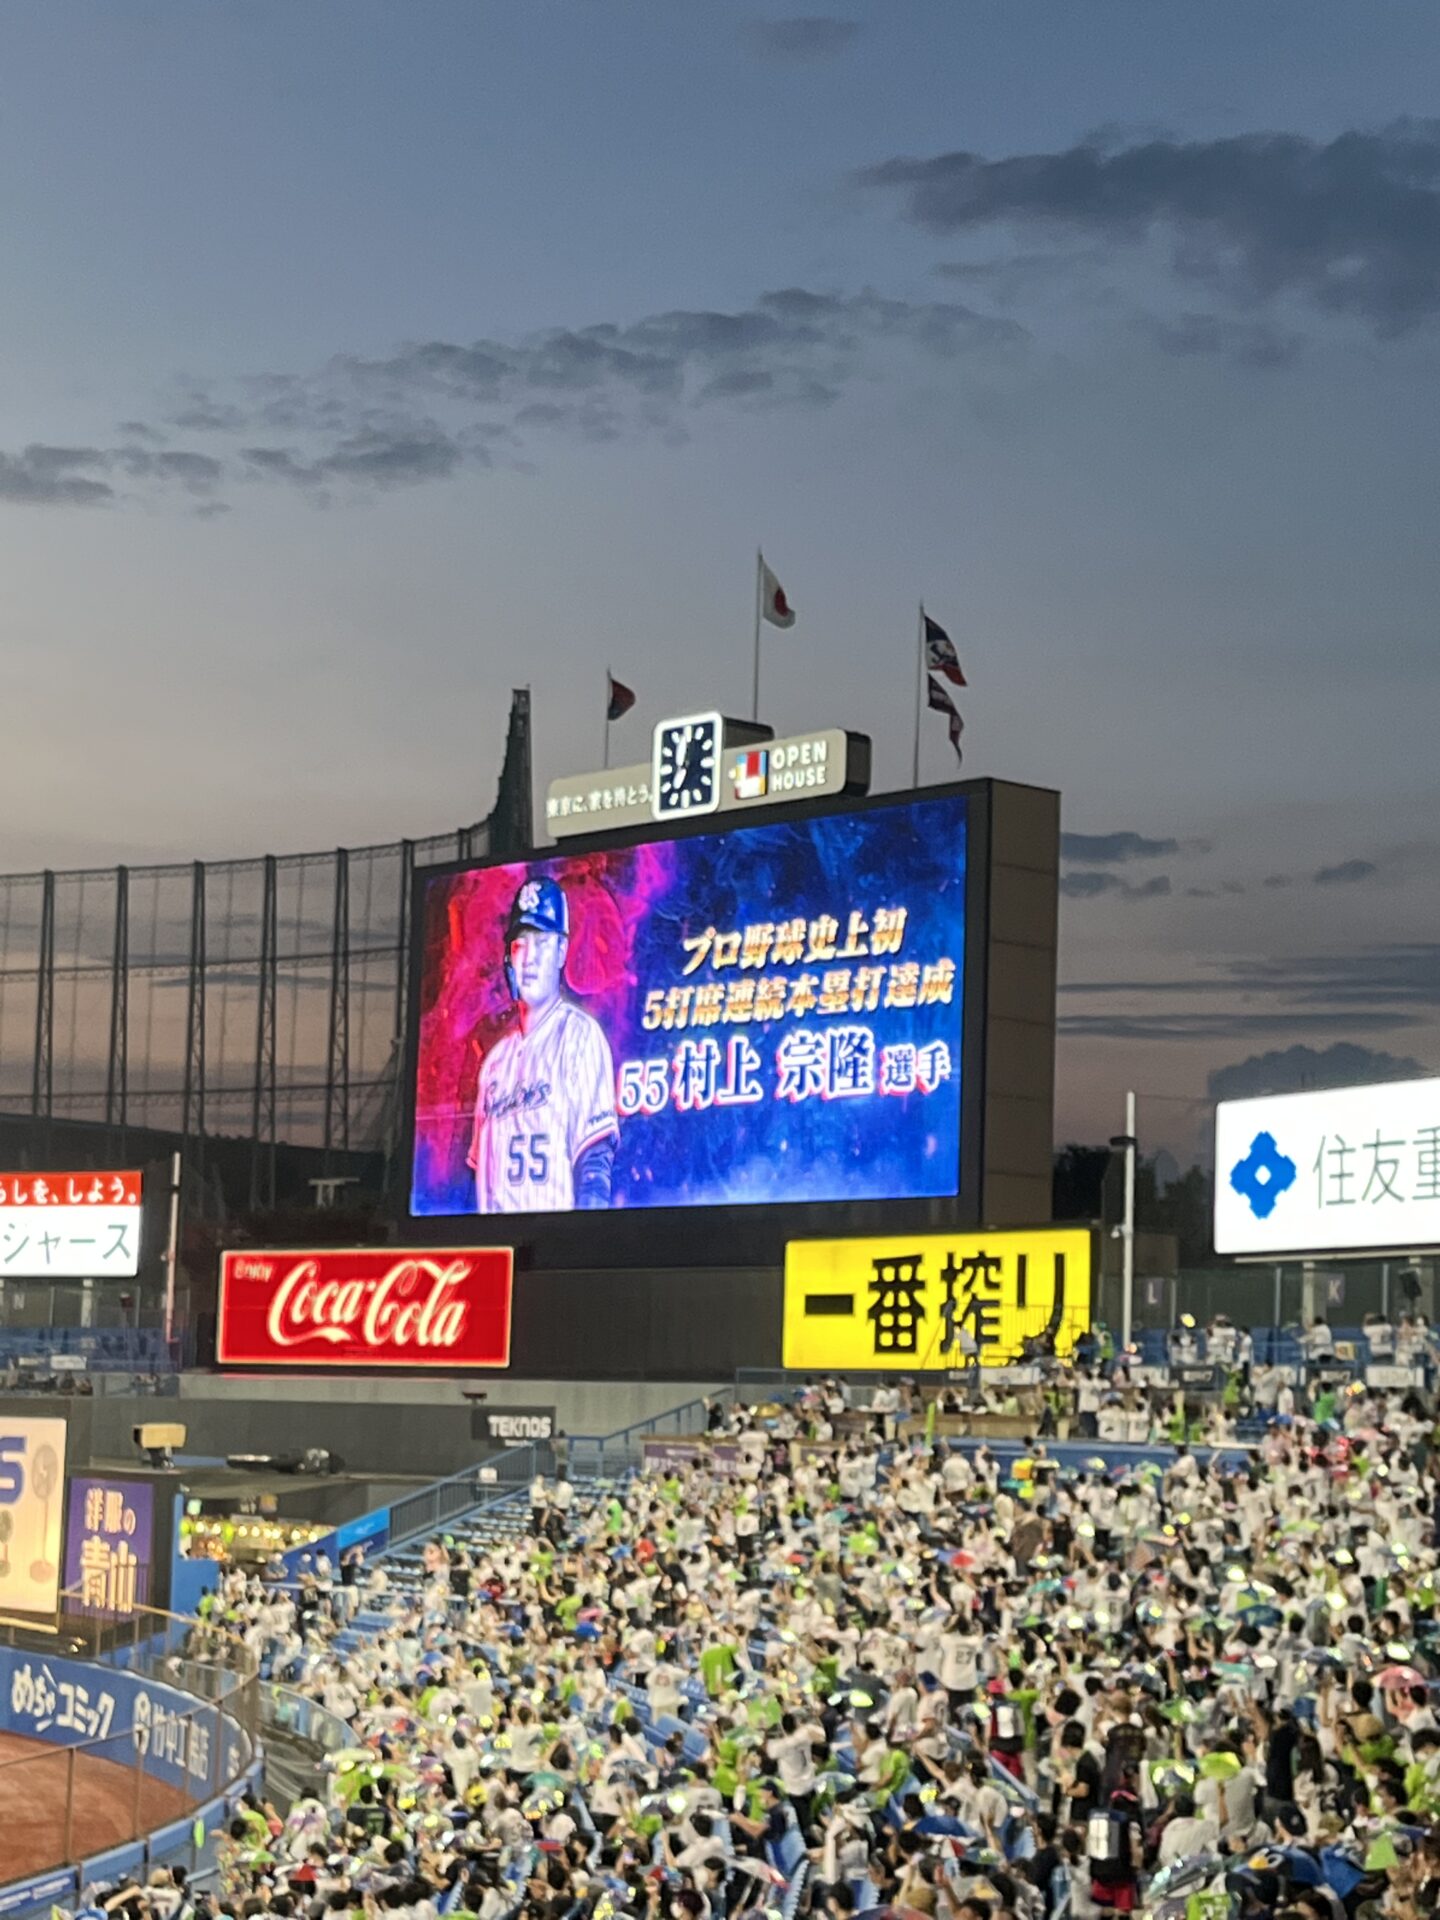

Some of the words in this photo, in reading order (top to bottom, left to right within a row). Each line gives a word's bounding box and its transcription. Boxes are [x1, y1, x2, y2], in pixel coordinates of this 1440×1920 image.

[771, 740, 827, 769] OPEN
[771, 766, 826, 792] HOUSE
[682, 907, 907, 976] プロ野球史上初
[641, 957, 956, 1030] 5打席連続本塁打達成
[618, 1059, 669, 1115] 55
[673, 1037, 764, 1111] 村上
[775, 1026, 875, 1103] 宗隆
[880, 1040, 952, 1096] 選手
[507, 1133, 549, 1186] 55
[1312, 1126, 1440, 1211] 住友重
[266, 1259, 473, 1347] Coca-Cola
[488, 1415, 552, 1438] TEKNOS
[85, 1487, 137, 1536] 洋服の
[80, 1535, 138, 1614] 青山
[12, 1663, 116, 1740] めちゃコミック
